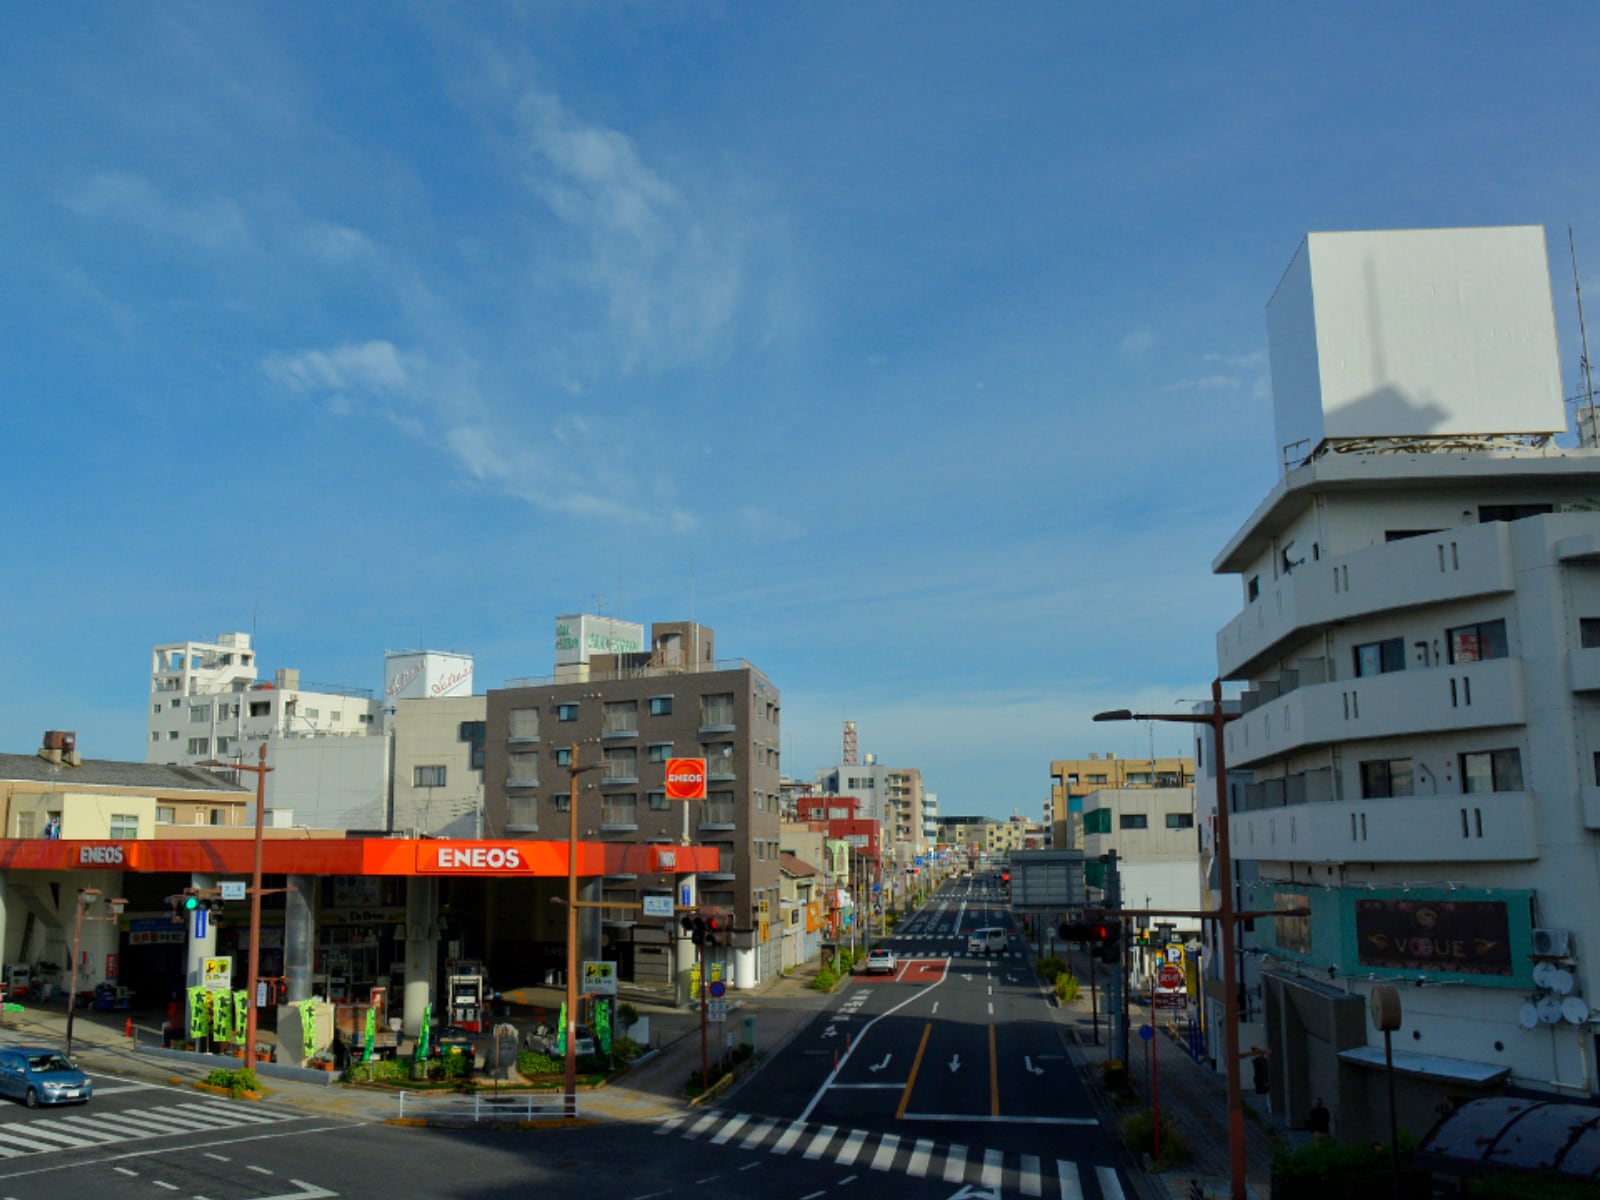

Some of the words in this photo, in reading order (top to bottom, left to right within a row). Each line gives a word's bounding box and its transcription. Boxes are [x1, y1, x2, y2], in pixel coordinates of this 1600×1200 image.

[668, 774, 702, 783] ENEOS
[80, 846, 123, 863] ENEOS
[437, 848, 520, 868] ENEOS
[1168, 947, 1181, 963] P
[1395, 937, 1466, 958] VOGUE
